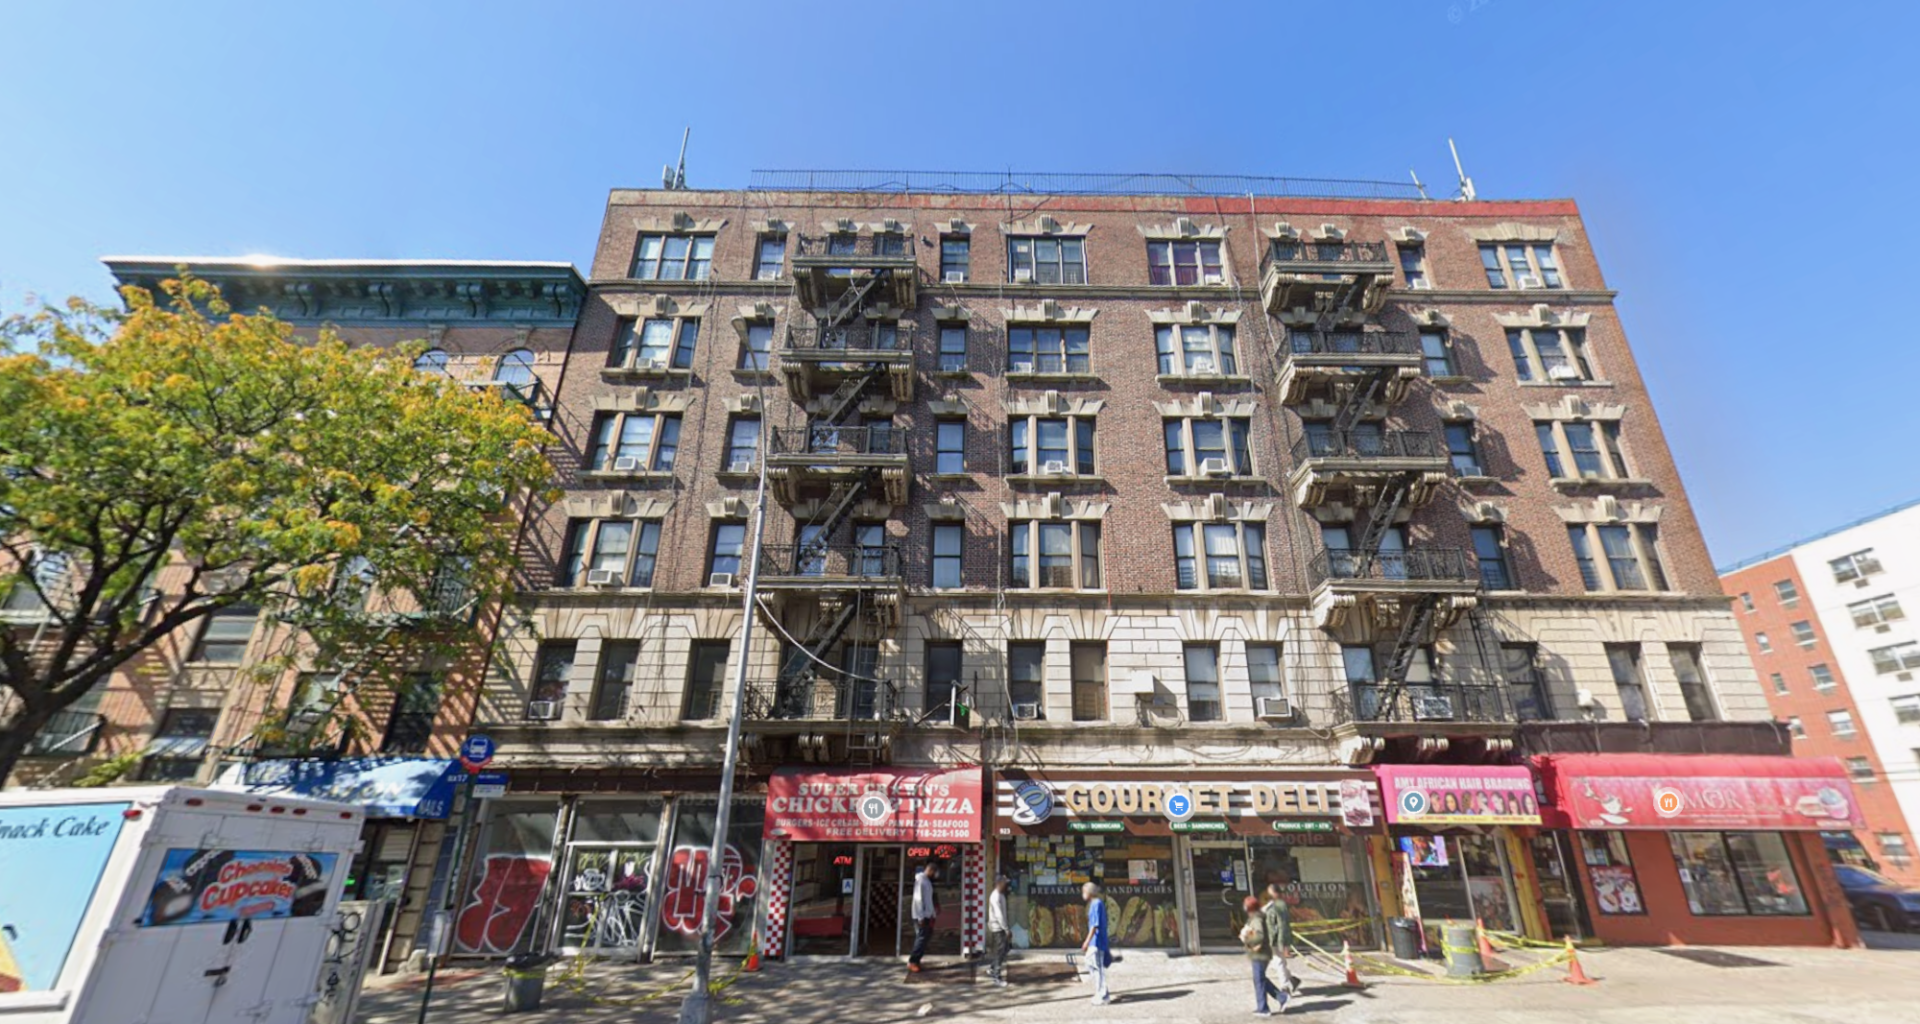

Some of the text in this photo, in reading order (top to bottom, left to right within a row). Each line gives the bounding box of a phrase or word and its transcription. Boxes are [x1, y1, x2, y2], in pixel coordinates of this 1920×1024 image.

[799, 782, 859, 796] SUPER
[1395, 776, 1531, 790] AMY AFRICAN HAIR BRAIDING
[1251, 783, 1331, 814] DELI
[908, 797, 975, 814] PIZZA
[0, 815, 110, 839] nack Cake
[775, 818, 813, 827] BURGERS
[816, 819, 830, 827] ICE
[905, 819, 928, 828] PIZZA
[932, 819, 969, 828] SEAFOOD
[826, 828, 970, 837] FREE DELIVERY 718-328-1500
[907, 847, 931, 857] OPEN
[833, 856, 853, 866] ATM
[844, 879, 851, 888] A
[200, 880, 297, 911] Cupcakes
[1031, 885, 1173, 895] BREAKFAS SANDWICHES
